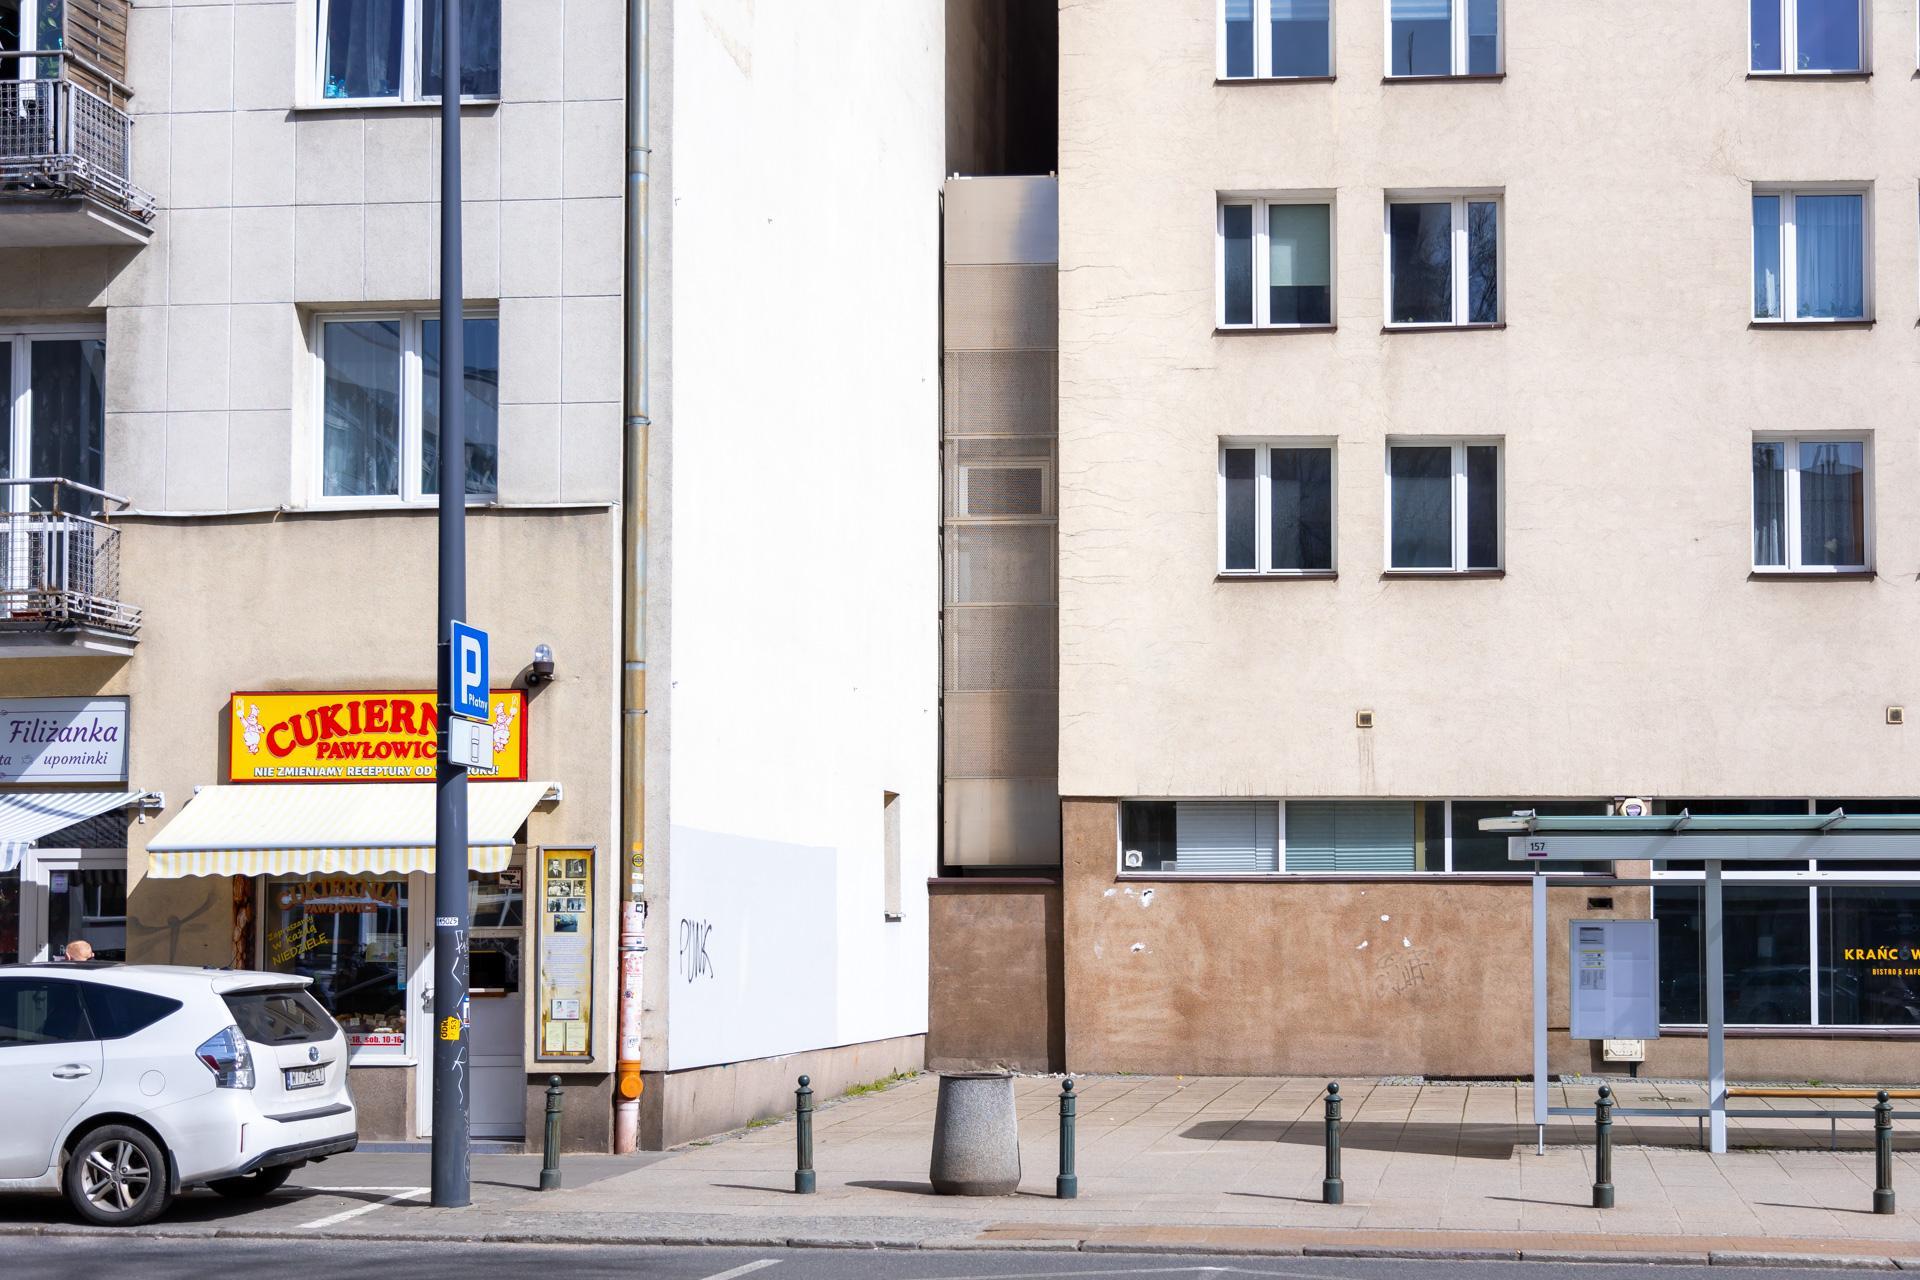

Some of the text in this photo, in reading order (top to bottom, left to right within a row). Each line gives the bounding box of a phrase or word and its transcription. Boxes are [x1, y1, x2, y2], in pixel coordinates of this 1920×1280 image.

[461, 635, 481, 704] P
[468, 694, 488, 713] Płatny
[9, 717, 119, 743] Filiżanka
[265, 700, 438, 758] CUKIERN
[43, 750, 109, 769] upominki
[315, 740, 438, 760] PAWŁOWIC
[253, 766, 276, 777] NIE
[277, 766, 343, 777] ZMIENIAMY
[346, 766, 415, 777] RECEPTURY
[417, 766, 431, 776] OD
[1530, 842, 1546, 851] 157
[275, 877, 399, 911] CUKIERNIA
[271, 932, 328, 966] NIEDZIELĘ
[1872, 968, 1896, 976] BISTRO
